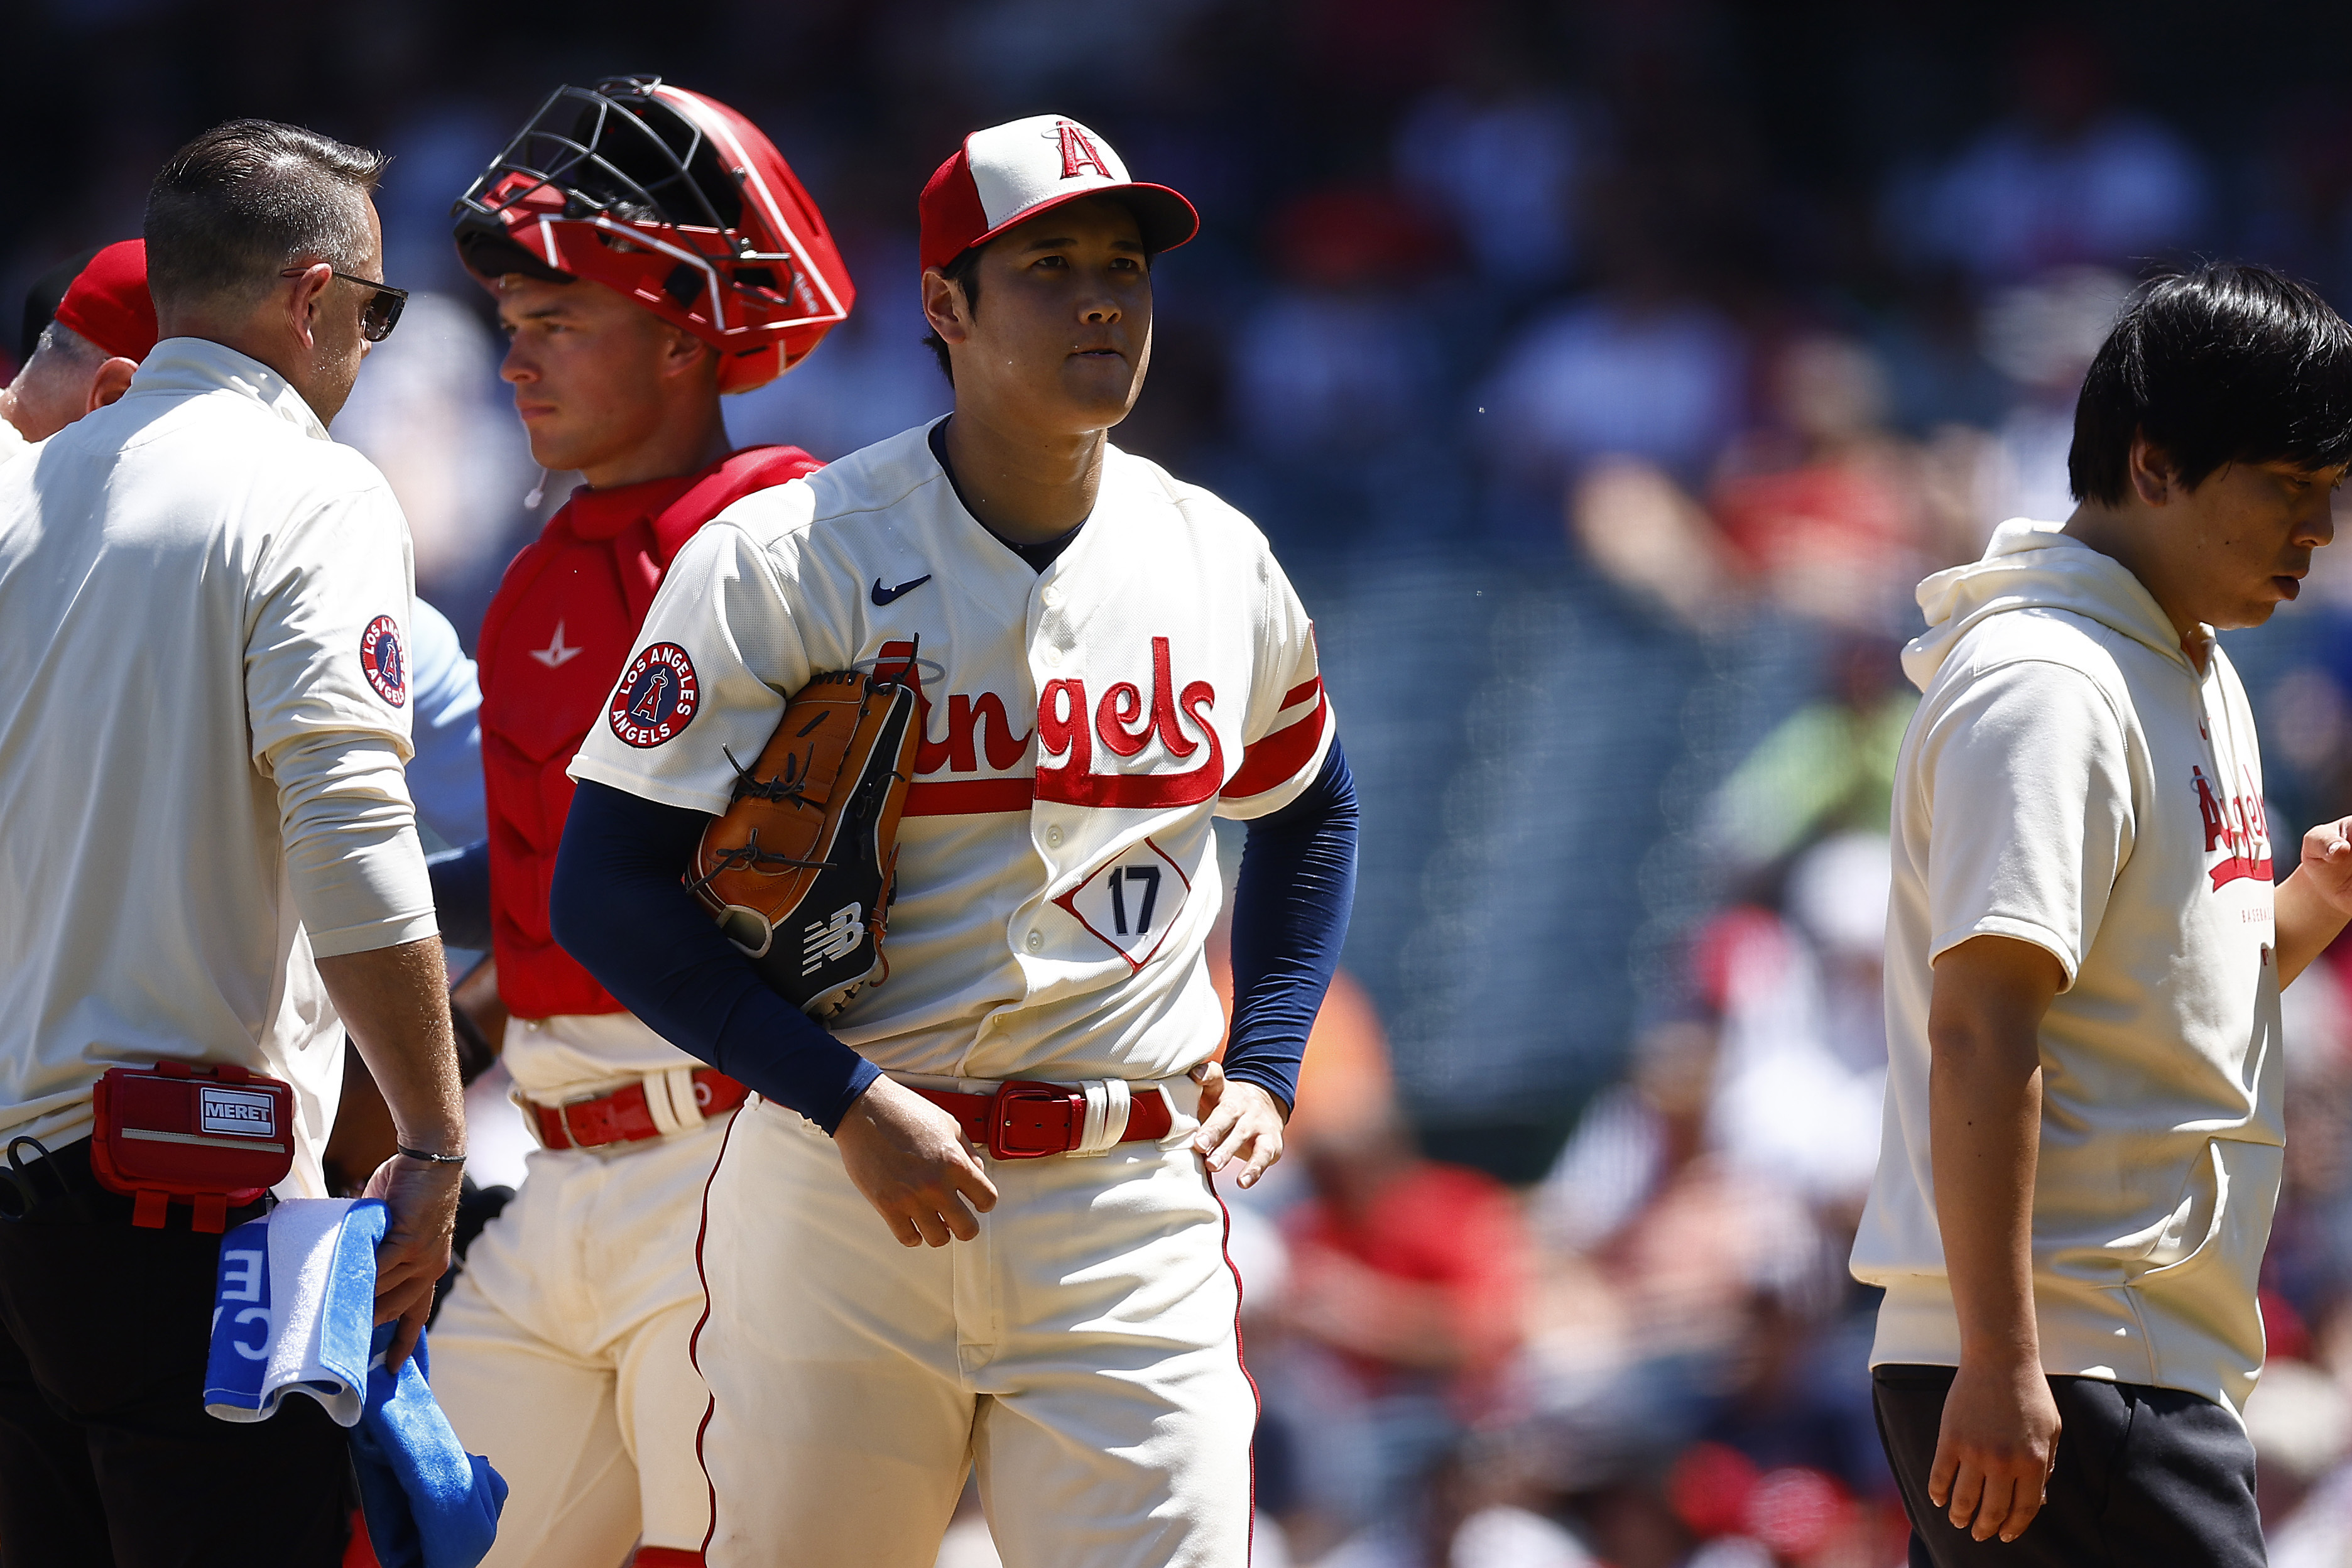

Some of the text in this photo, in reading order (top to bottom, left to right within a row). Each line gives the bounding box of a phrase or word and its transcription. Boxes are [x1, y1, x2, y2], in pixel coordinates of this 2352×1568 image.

[1055, 119, 1115, 181] A
[364, 624, 380, 655] LOS
[367, 669, 404, 704] ANGELS
[619, 647, 694, 716] LOS ANGELES
[613, 709, 671, 744] ANGELS
[1108, 864, 1162, 937] 17
[205, 1102, 270, 1121] MERET
